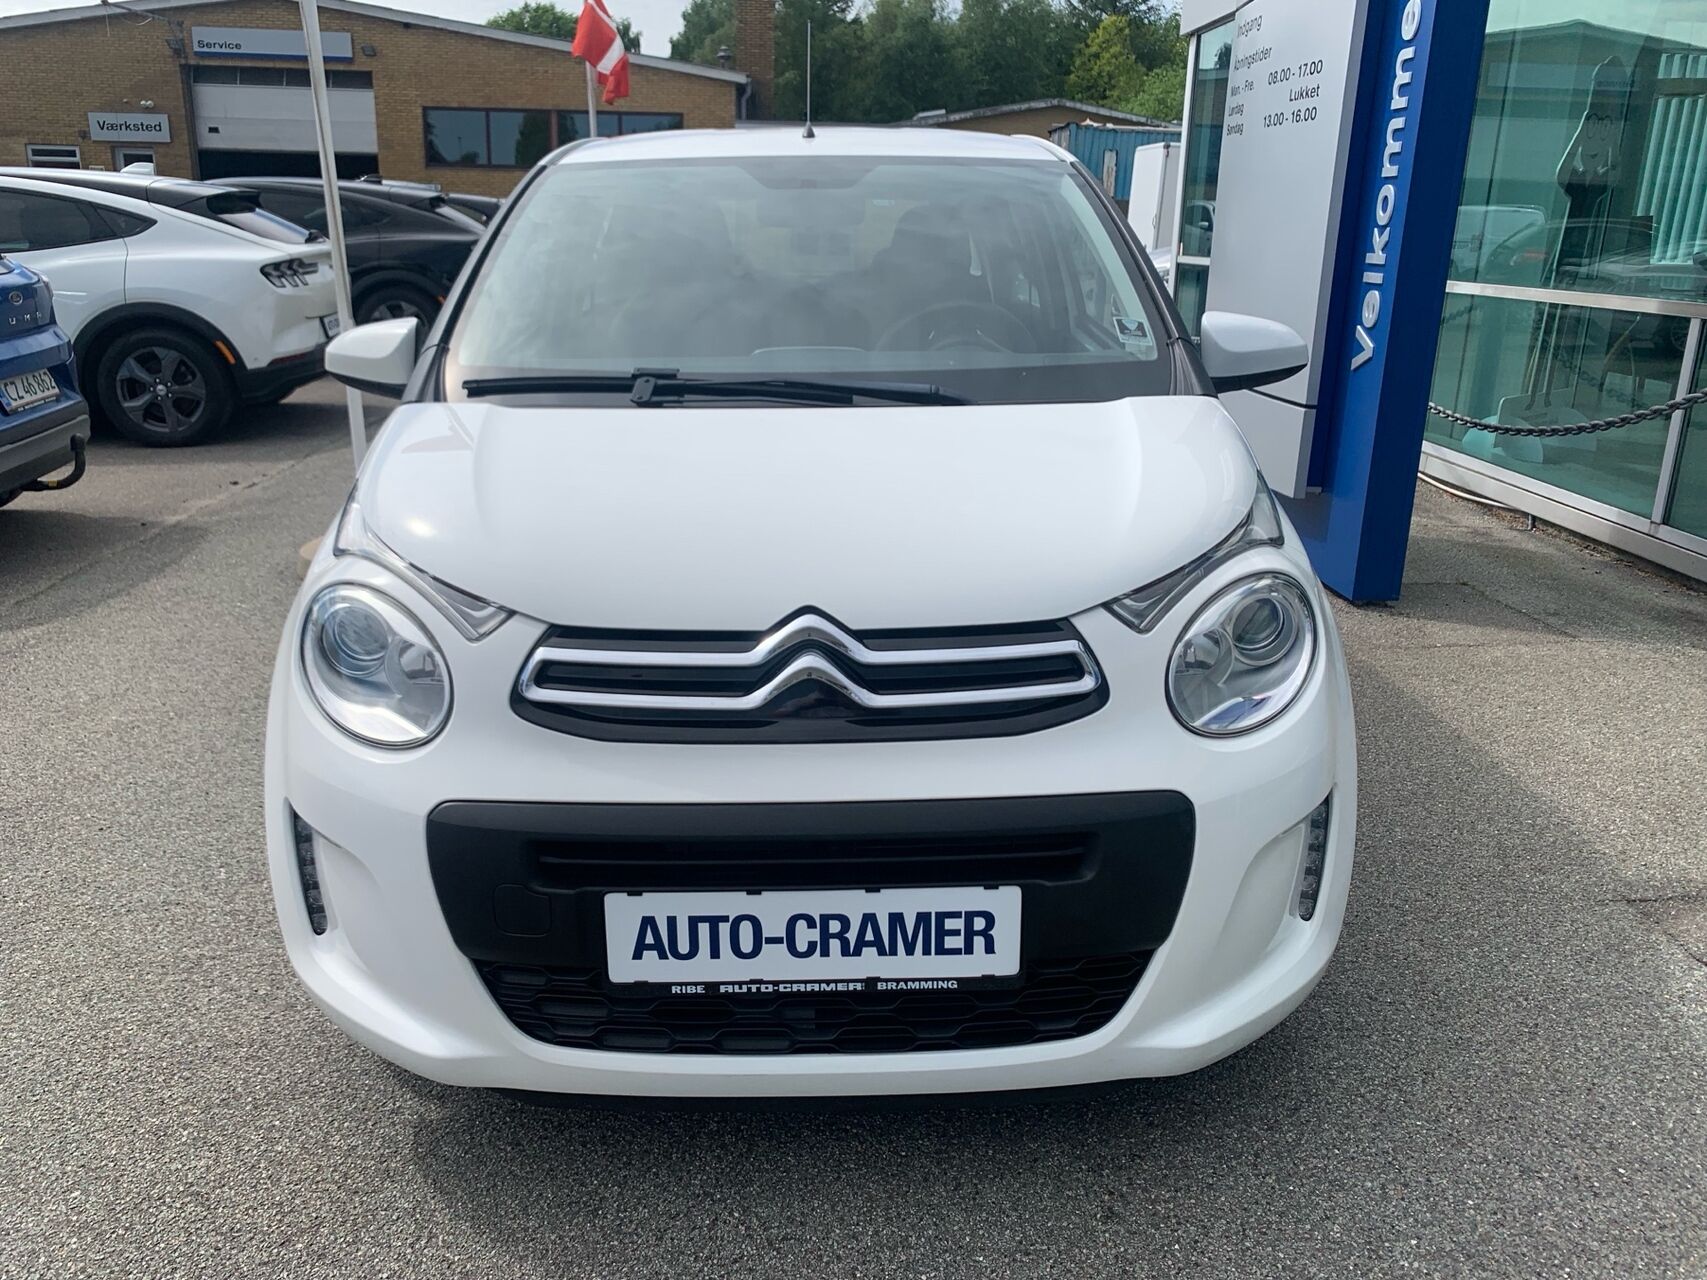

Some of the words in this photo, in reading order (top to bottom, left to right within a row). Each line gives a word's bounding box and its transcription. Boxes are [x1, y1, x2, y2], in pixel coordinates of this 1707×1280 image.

[197, 39, 242, 50] Service
[1267, 67, 1291, 86] 08.00
[1298, 59, 1323, 78] 17.00
[1289, 83, 1320, 102] Lukket
[97, 120, 162, 132] Værksted
[1263, 112, 1284, 128] 13.00
[1291, 106, 1317, 124] 16.00
[631, 910, 997, 961] AUTO-CRAMER
[671, 985, 705, 994] RIBE
[719, 982, 864, 993] AUTO-CRAMER
[877, 980, 958, 991] BRAMMING
